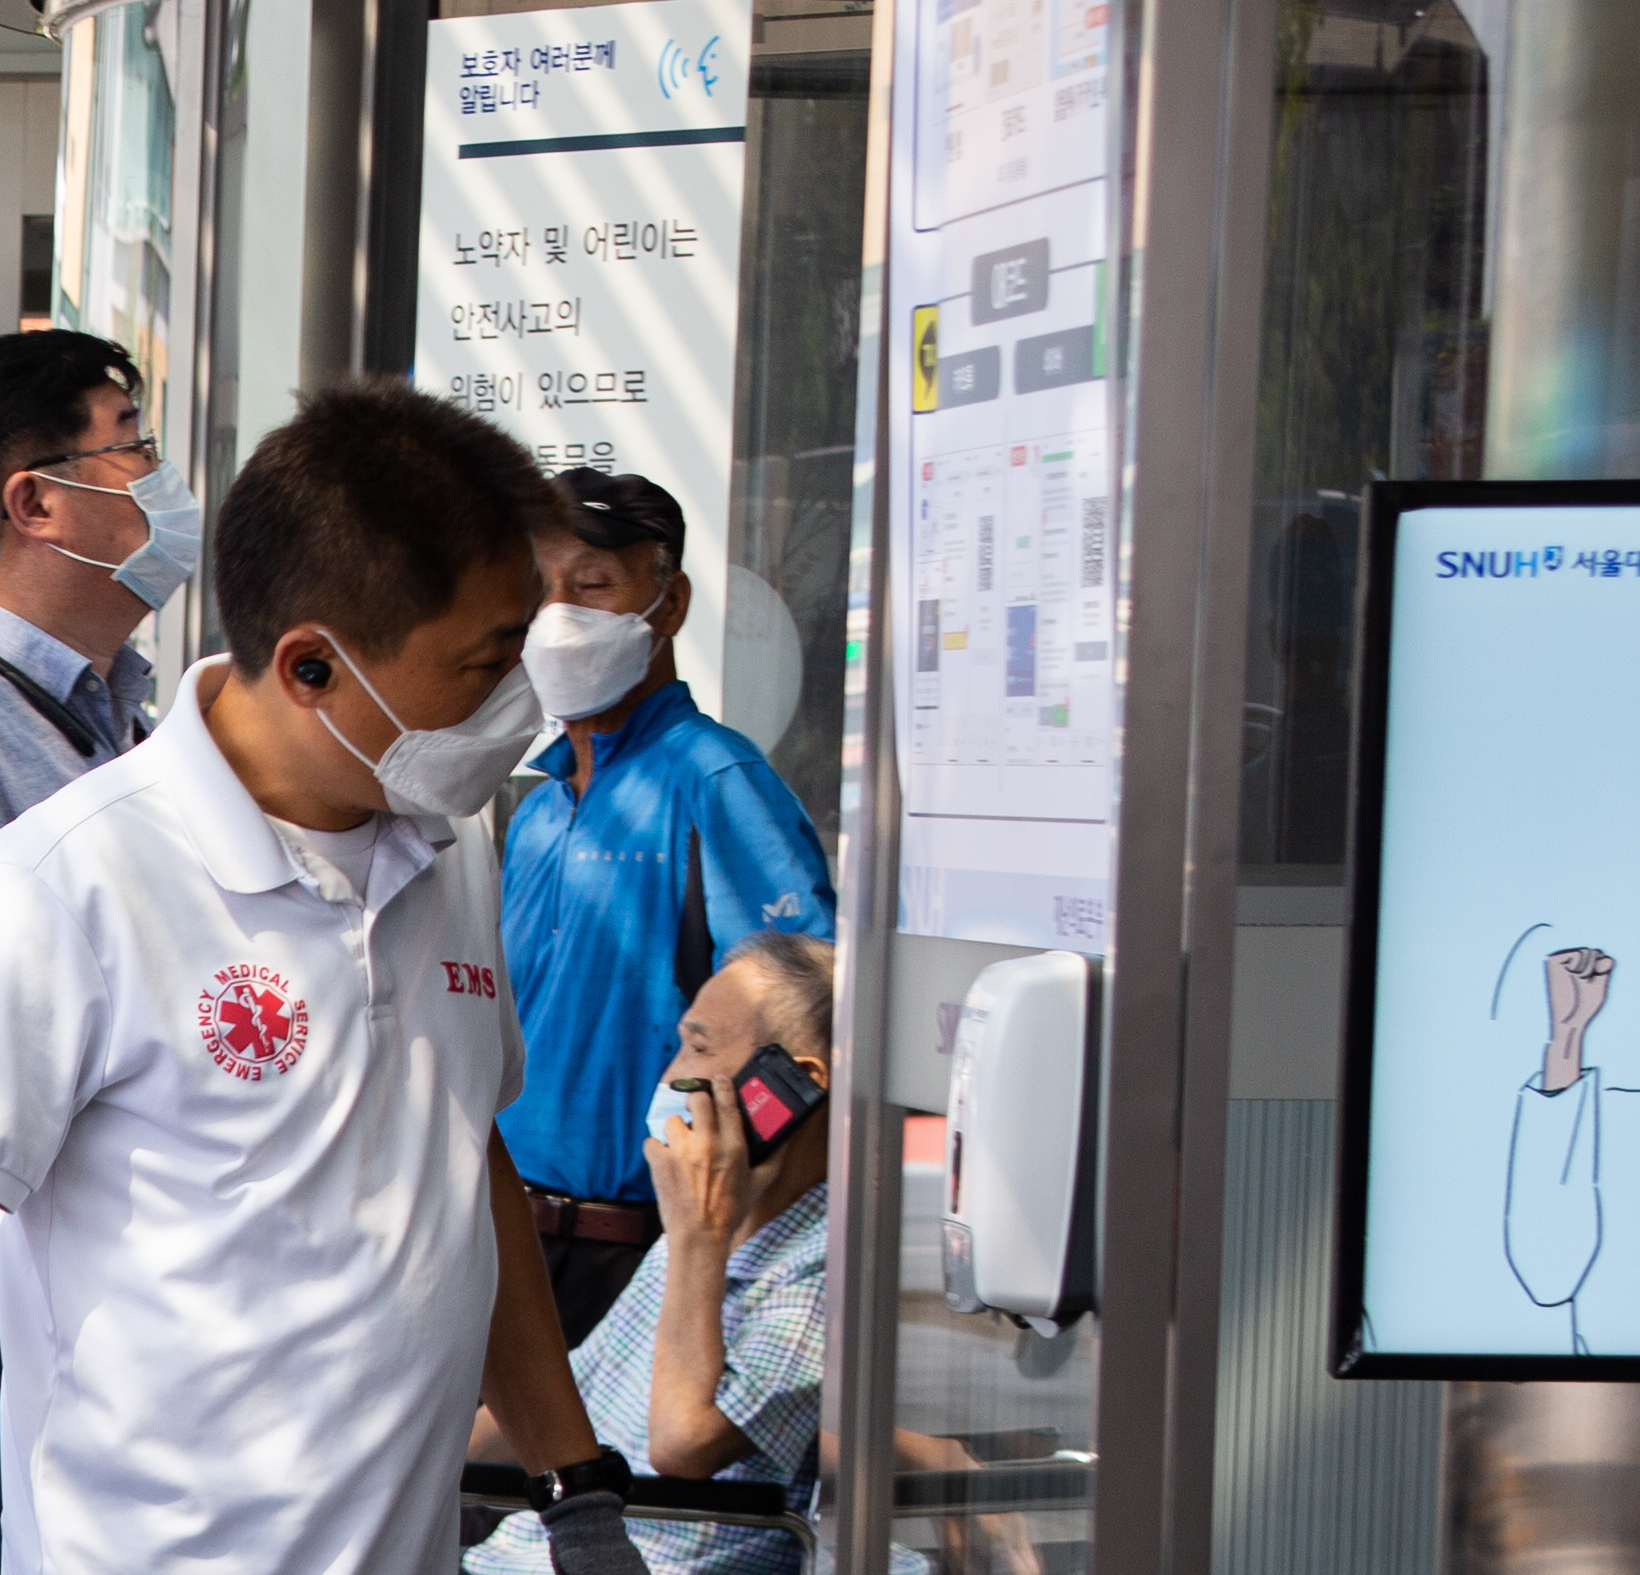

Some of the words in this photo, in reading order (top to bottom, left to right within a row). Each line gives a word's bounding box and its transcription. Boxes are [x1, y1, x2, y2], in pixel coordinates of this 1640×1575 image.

[459, 47, 521, 78] 보호자
[530, 39, 616, 74] 여러분께
[459, 80, 540, 115] 알립니다
[453, 226, 531, 268] 노약자
[544, 223, 569, 264] 및
[583, 219, 698, 261] 어린이는
[451, 297, 581, 341] 안전사고의
[538, 370, 648, 410] 있으므로
[1436, 550, 1538, 578] SNUH
[214, 963, 290, 994] MEDICAL
[441, 960, 497, 999] EMS
[197, 989, 262, 1082] EMERGENCY
[277, 999, 309, 1076] SERVICE
